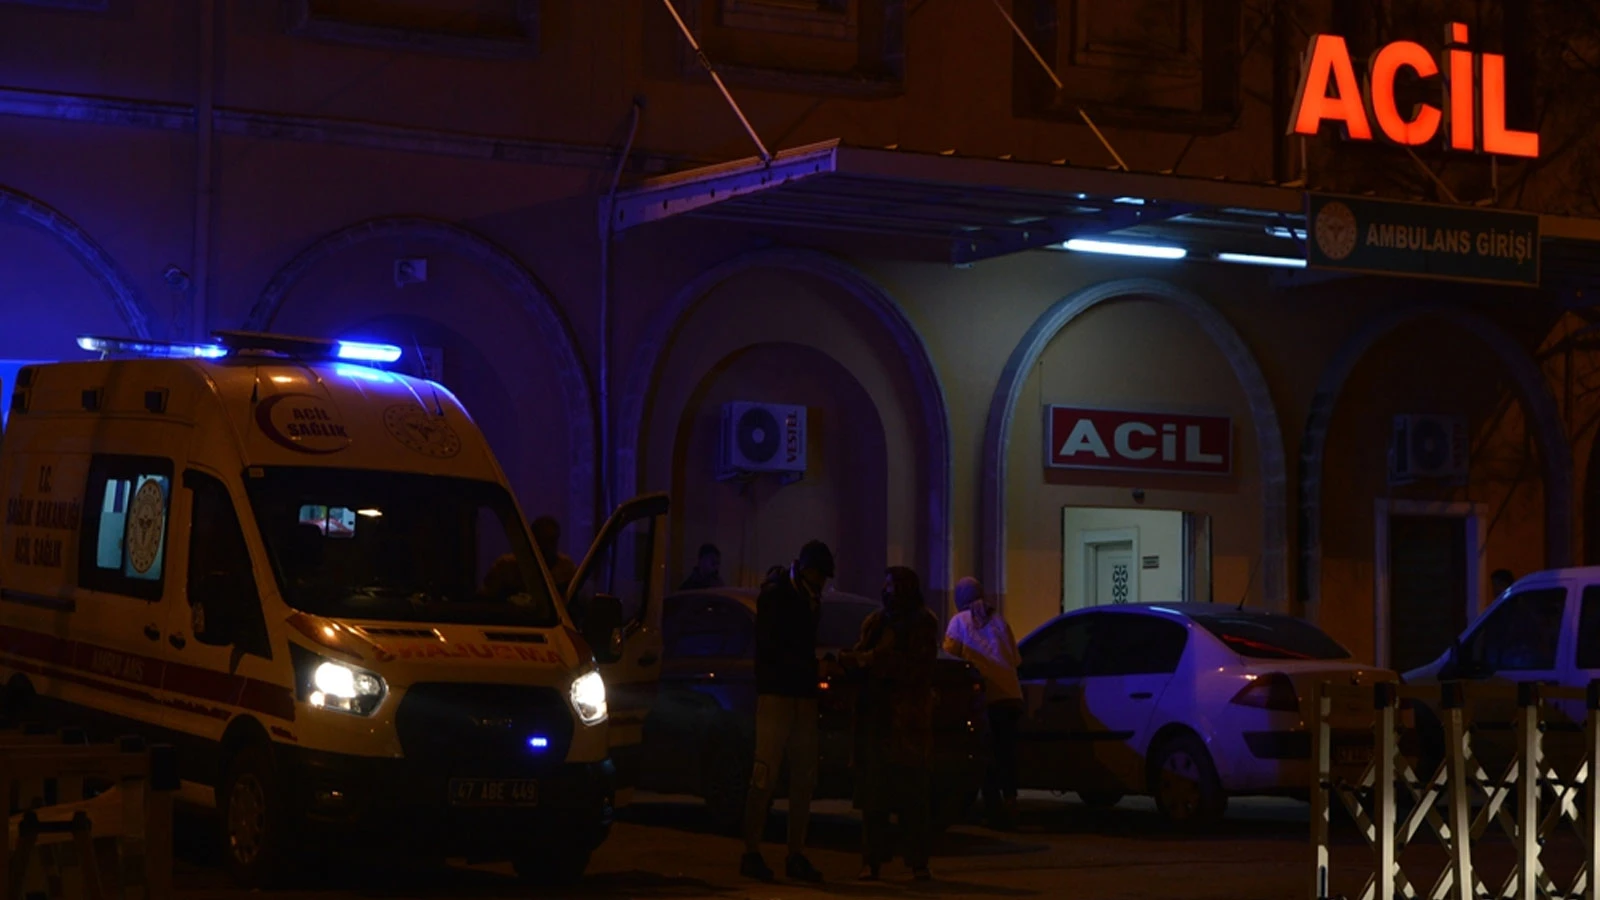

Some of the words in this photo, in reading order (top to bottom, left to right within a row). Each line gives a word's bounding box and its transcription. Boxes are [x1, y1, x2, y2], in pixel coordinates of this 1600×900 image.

[1291, 20, 1541, 159] ACİL
[1366, 222, 1472, 255] AMBULANS
[1475, 227, 1534, 264] GİRİŞİ
[288, 421, 348, 438] SAĞLIK
[458, 781, 475, 800] 47
[480, 781, 505, 801] ABE
[511, 781, 536, 801] 449
